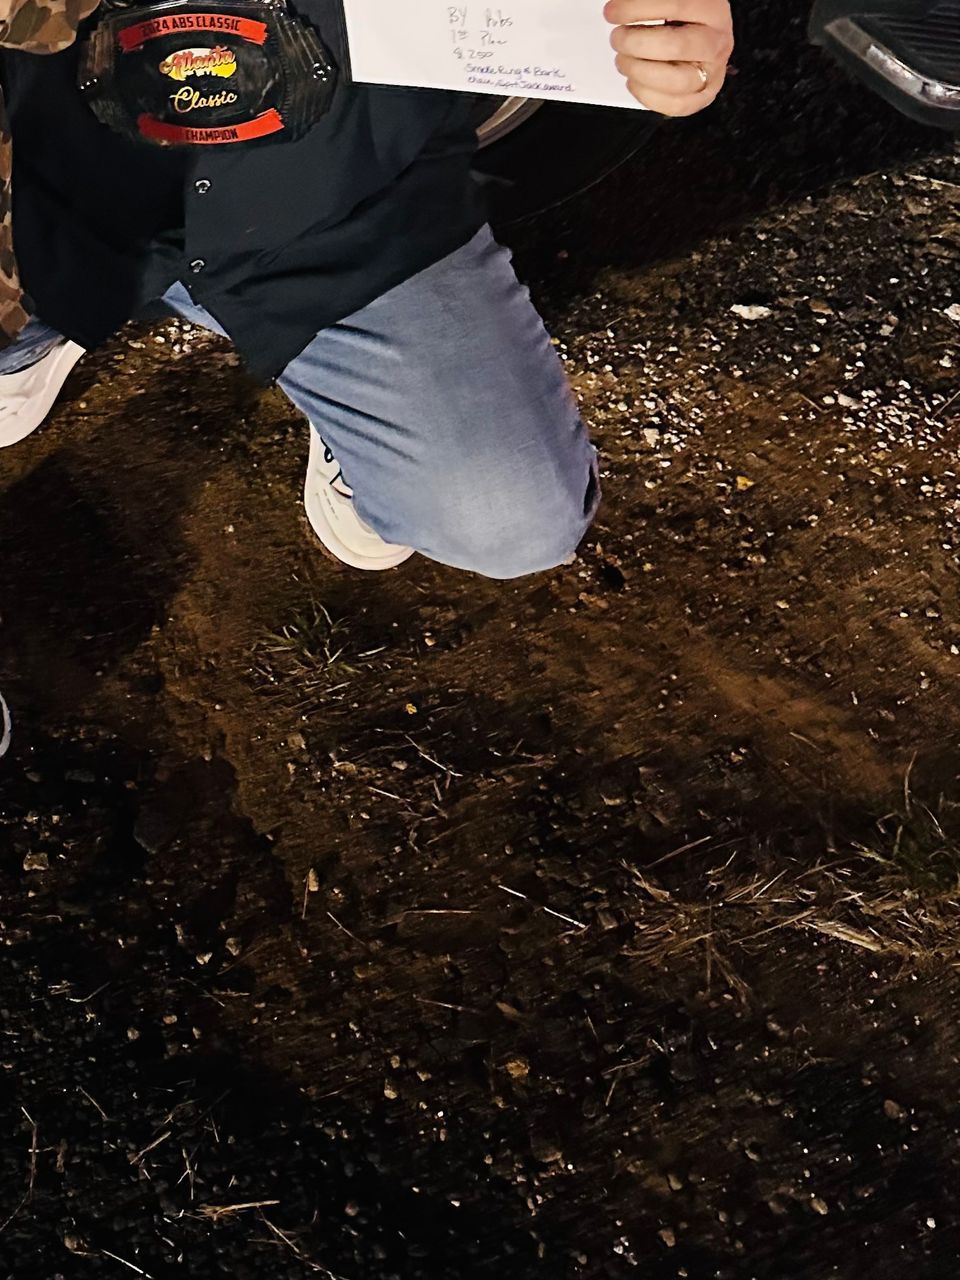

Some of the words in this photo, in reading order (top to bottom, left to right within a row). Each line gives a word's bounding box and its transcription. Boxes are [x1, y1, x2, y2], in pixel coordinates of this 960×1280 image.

[172, 16, 194, 29] ABS
[196, 16, 242, 32] CLASSIC
[159, 44, 237, 78] Atlanta
[169, 86, 237, 113] Classic
[185, 128, 239, 142] CHAMPION
